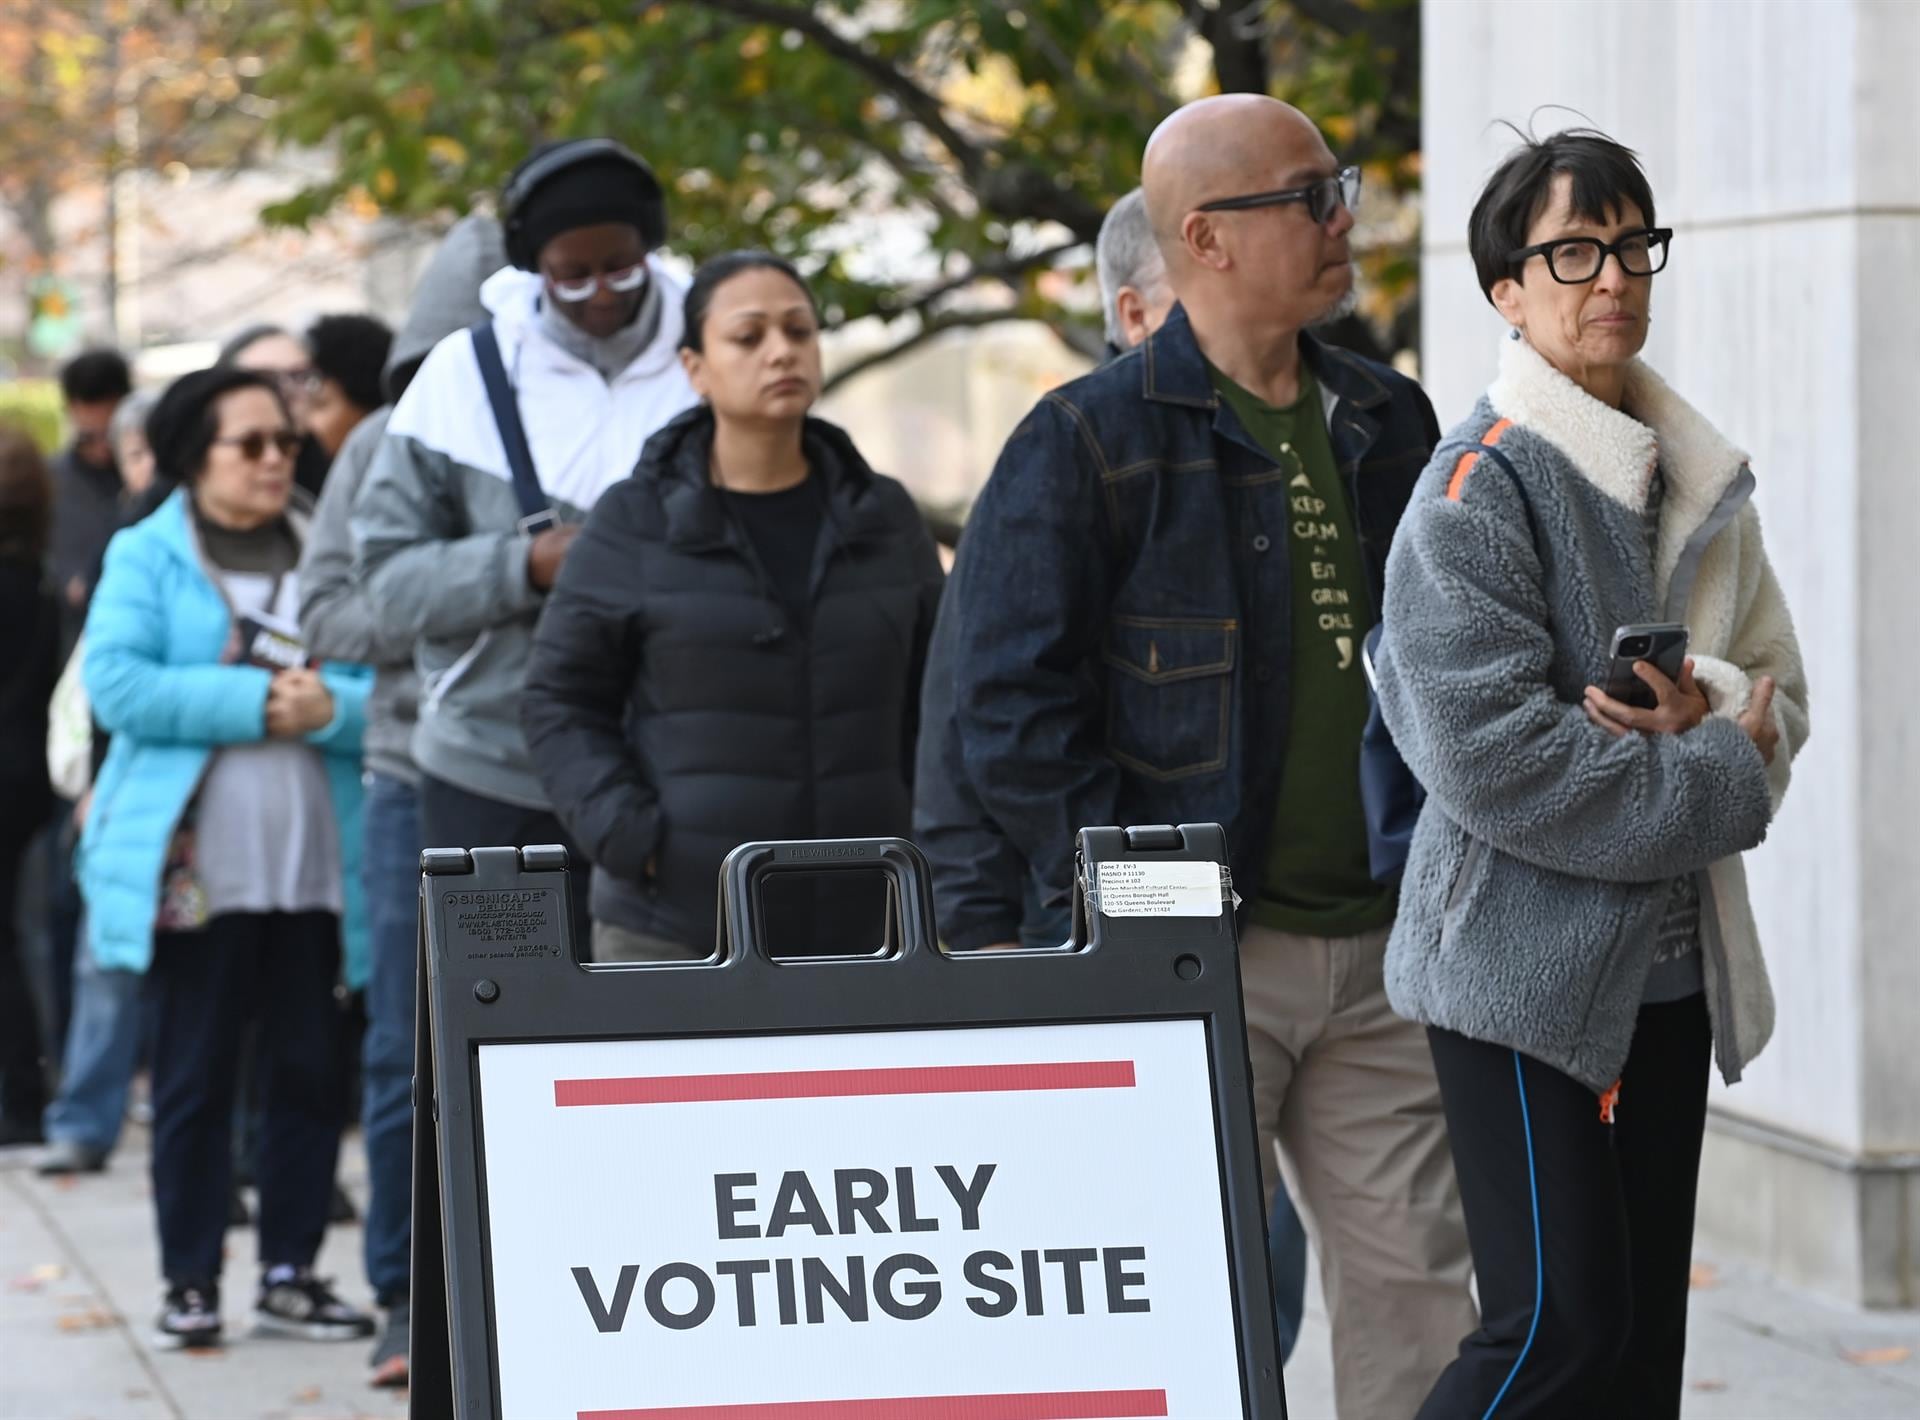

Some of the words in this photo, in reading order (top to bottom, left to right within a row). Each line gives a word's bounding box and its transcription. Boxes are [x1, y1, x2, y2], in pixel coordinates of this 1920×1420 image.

[479, 903, 525, 912] DELUXE
[516, 950, 544, 958] pending
[713, 1163, 998, 1240] EARLY
[570, 1253, 942, 1333] VOTING
[962, 1246, 1151, 1318] SITE
